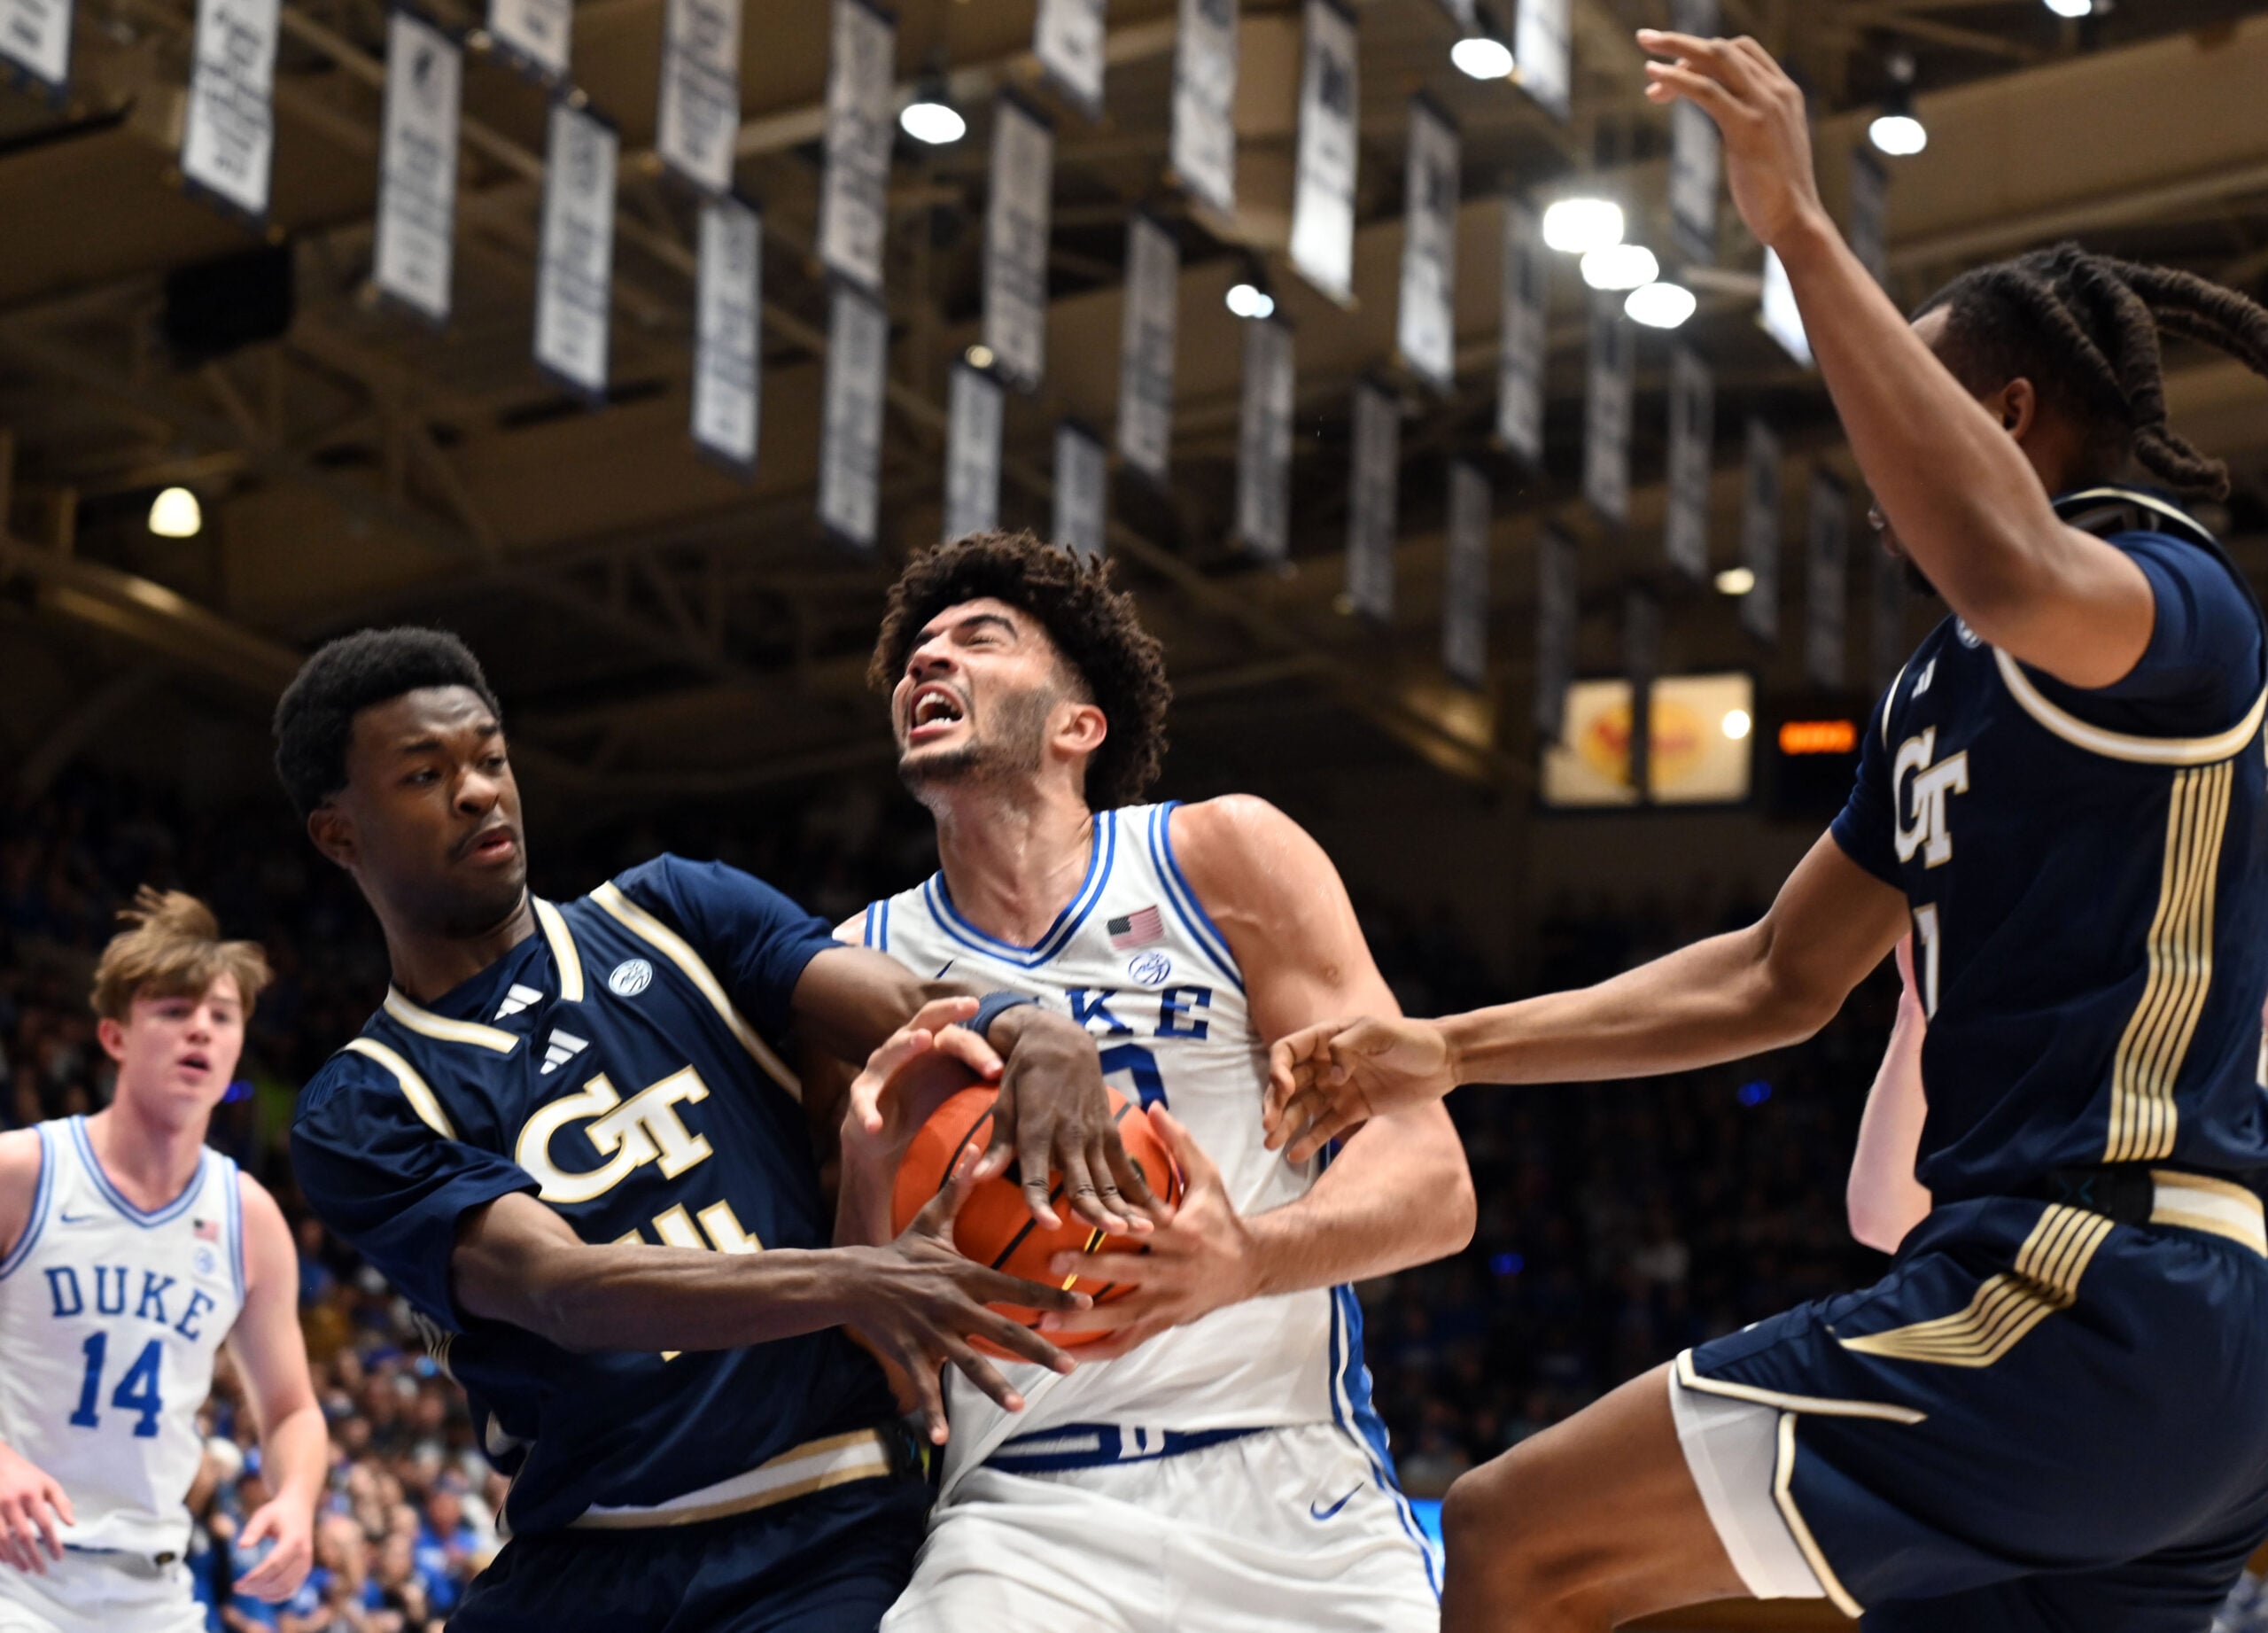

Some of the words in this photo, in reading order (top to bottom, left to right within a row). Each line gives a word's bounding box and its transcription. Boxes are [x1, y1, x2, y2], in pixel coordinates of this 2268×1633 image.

[1032, 985, 1212, 1040] KE
[515, 1063, 714, 1203] GT
[44, 1265, 215, 1342] DUKE
[69, 1330, 163, 1438] 14
